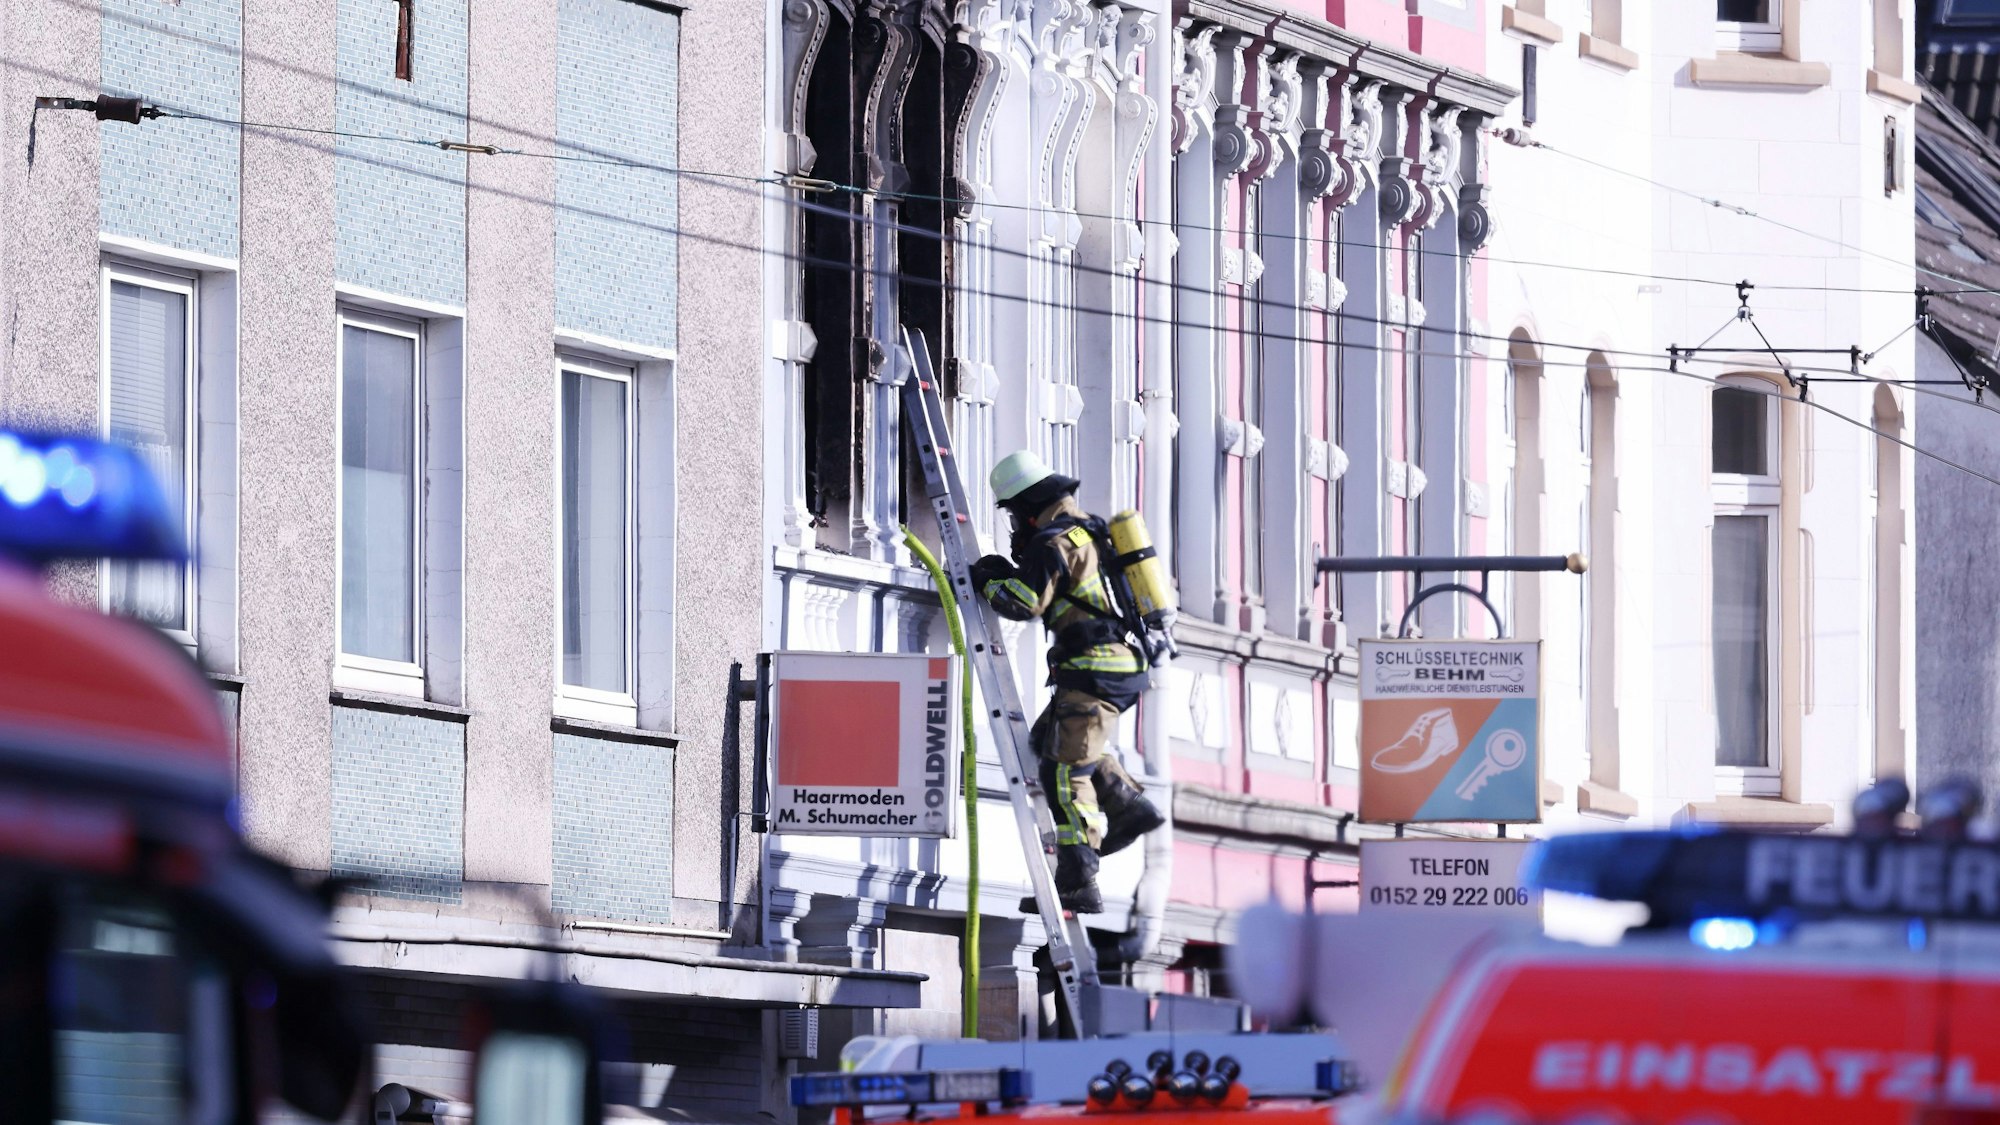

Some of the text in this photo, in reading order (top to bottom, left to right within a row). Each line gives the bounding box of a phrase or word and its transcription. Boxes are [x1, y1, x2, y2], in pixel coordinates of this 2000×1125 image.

[1375, 647, 1524, 666] SCHLÜSSELTECHNIK
[1414, 668, 1485, 681] BEHM
[1375, 684, 1524, 694] HANDWERKLICHE DIENSTLEISTUNGEN
[793, 788, 905, 806] Haarmoden
[778, 808, 917, 826] M. Schumacher
[1409, 857, 1490, 876] TELEFON
[1370, 886, 1528, 906] 0152 29 222 006
